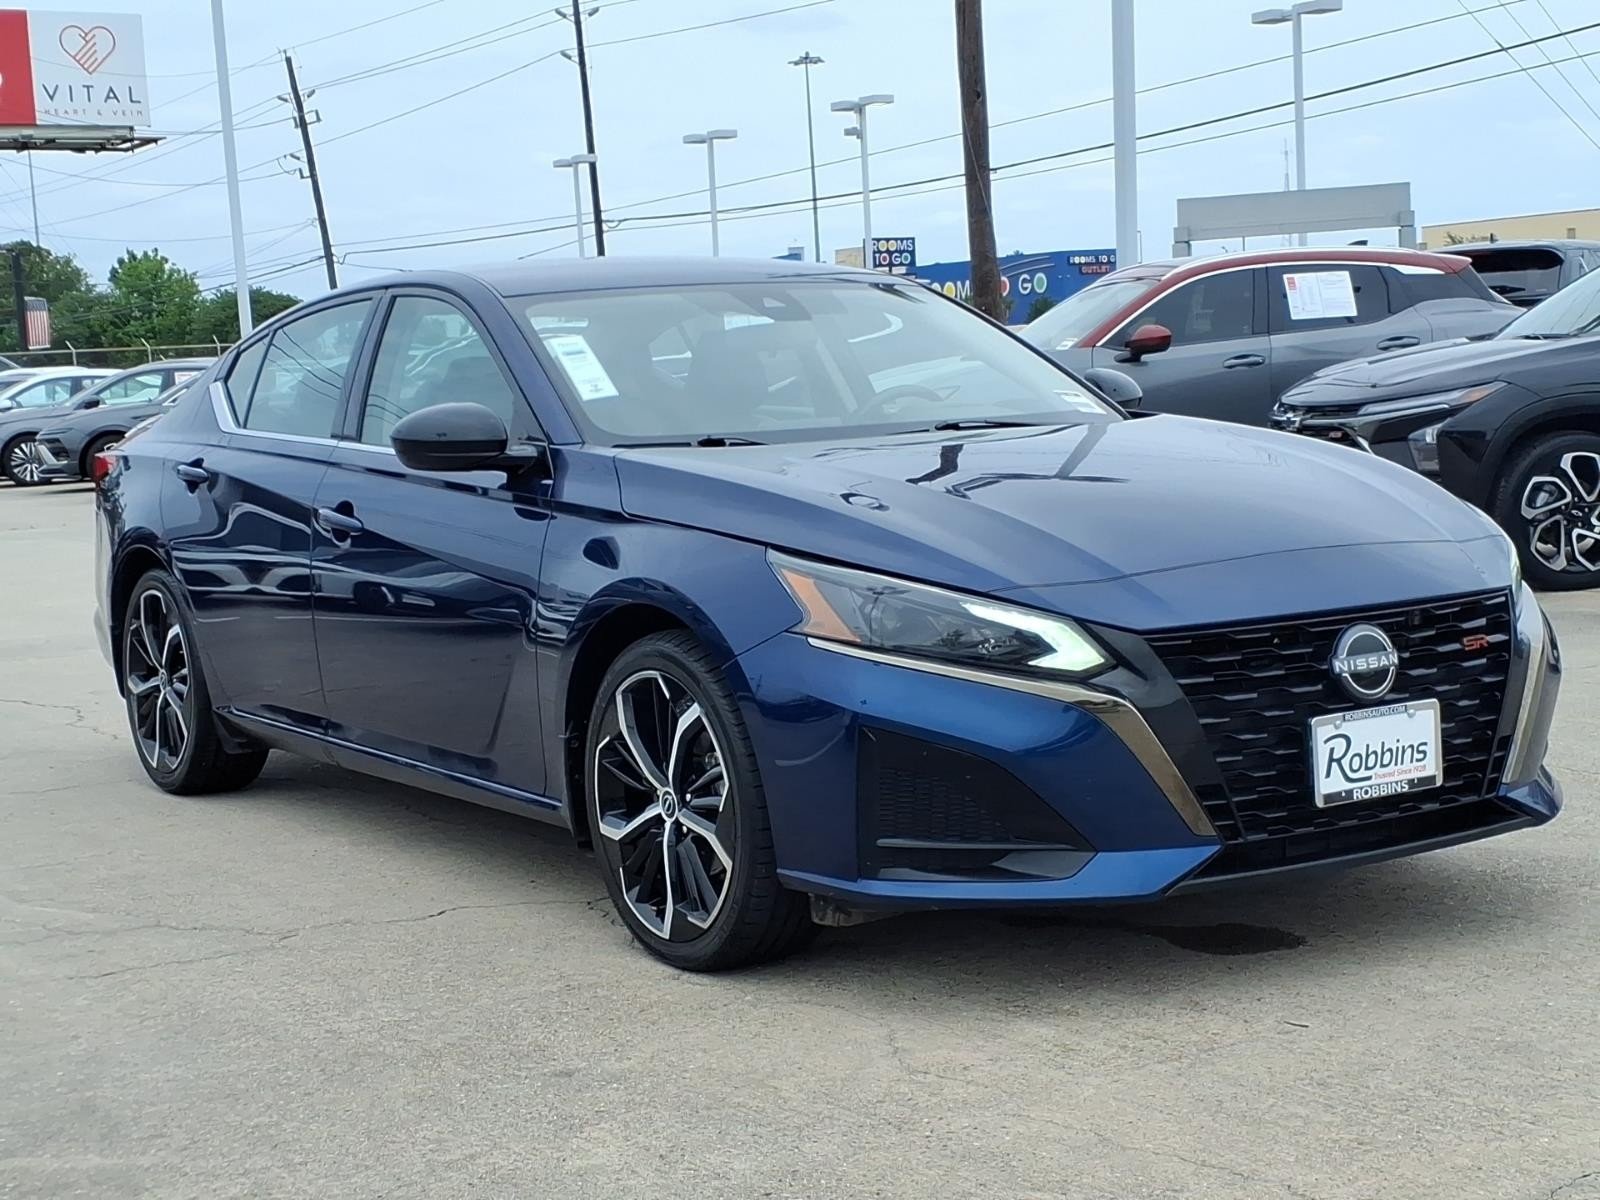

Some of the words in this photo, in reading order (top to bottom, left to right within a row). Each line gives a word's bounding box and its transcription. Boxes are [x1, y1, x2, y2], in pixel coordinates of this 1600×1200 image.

[42, 83, 142, 104] VITAL
[44, 108, 86, 116] HEART
[872, 239, 913, 251] ROOMS
[875, 253, 890, 265] TO
[891, 252, 911, 264] GO
[1069, 255, 1096, 264] ROOMS
[1098, 254, 1108, 263] TO
[1081, 265, 1110, 273] OUTLET
[1018, 272, 1047, 295] GO
[1463, 634, 1489, 651] SR
[1335, 653, 1398, 673] NISSAN
[1323, 733, 1428, 783] Robbins
[1353, 780, 1409, 800] ROBBINS
